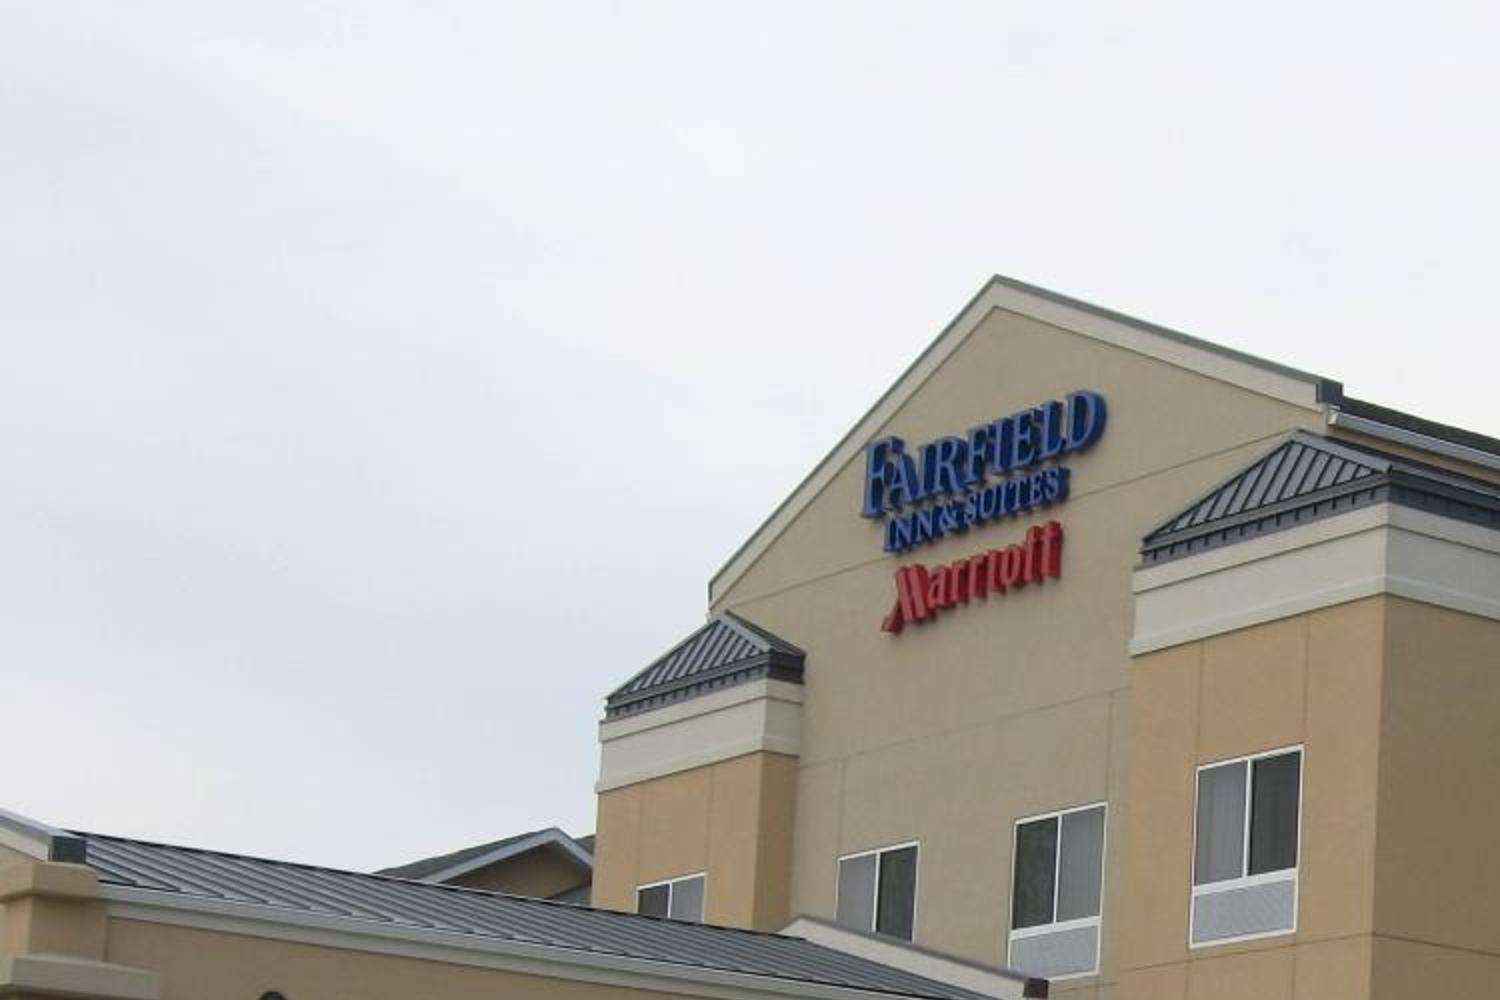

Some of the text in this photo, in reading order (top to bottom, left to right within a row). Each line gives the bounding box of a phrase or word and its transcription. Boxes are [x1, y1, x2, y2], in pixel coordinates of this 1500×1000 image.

[862, 390, 1107, 519] FAIRFIELD
[884, 507, 938, 553] INN
[963, 465, 1071, 528] SUITES
[881, 519, 1065, 635] Marriott
